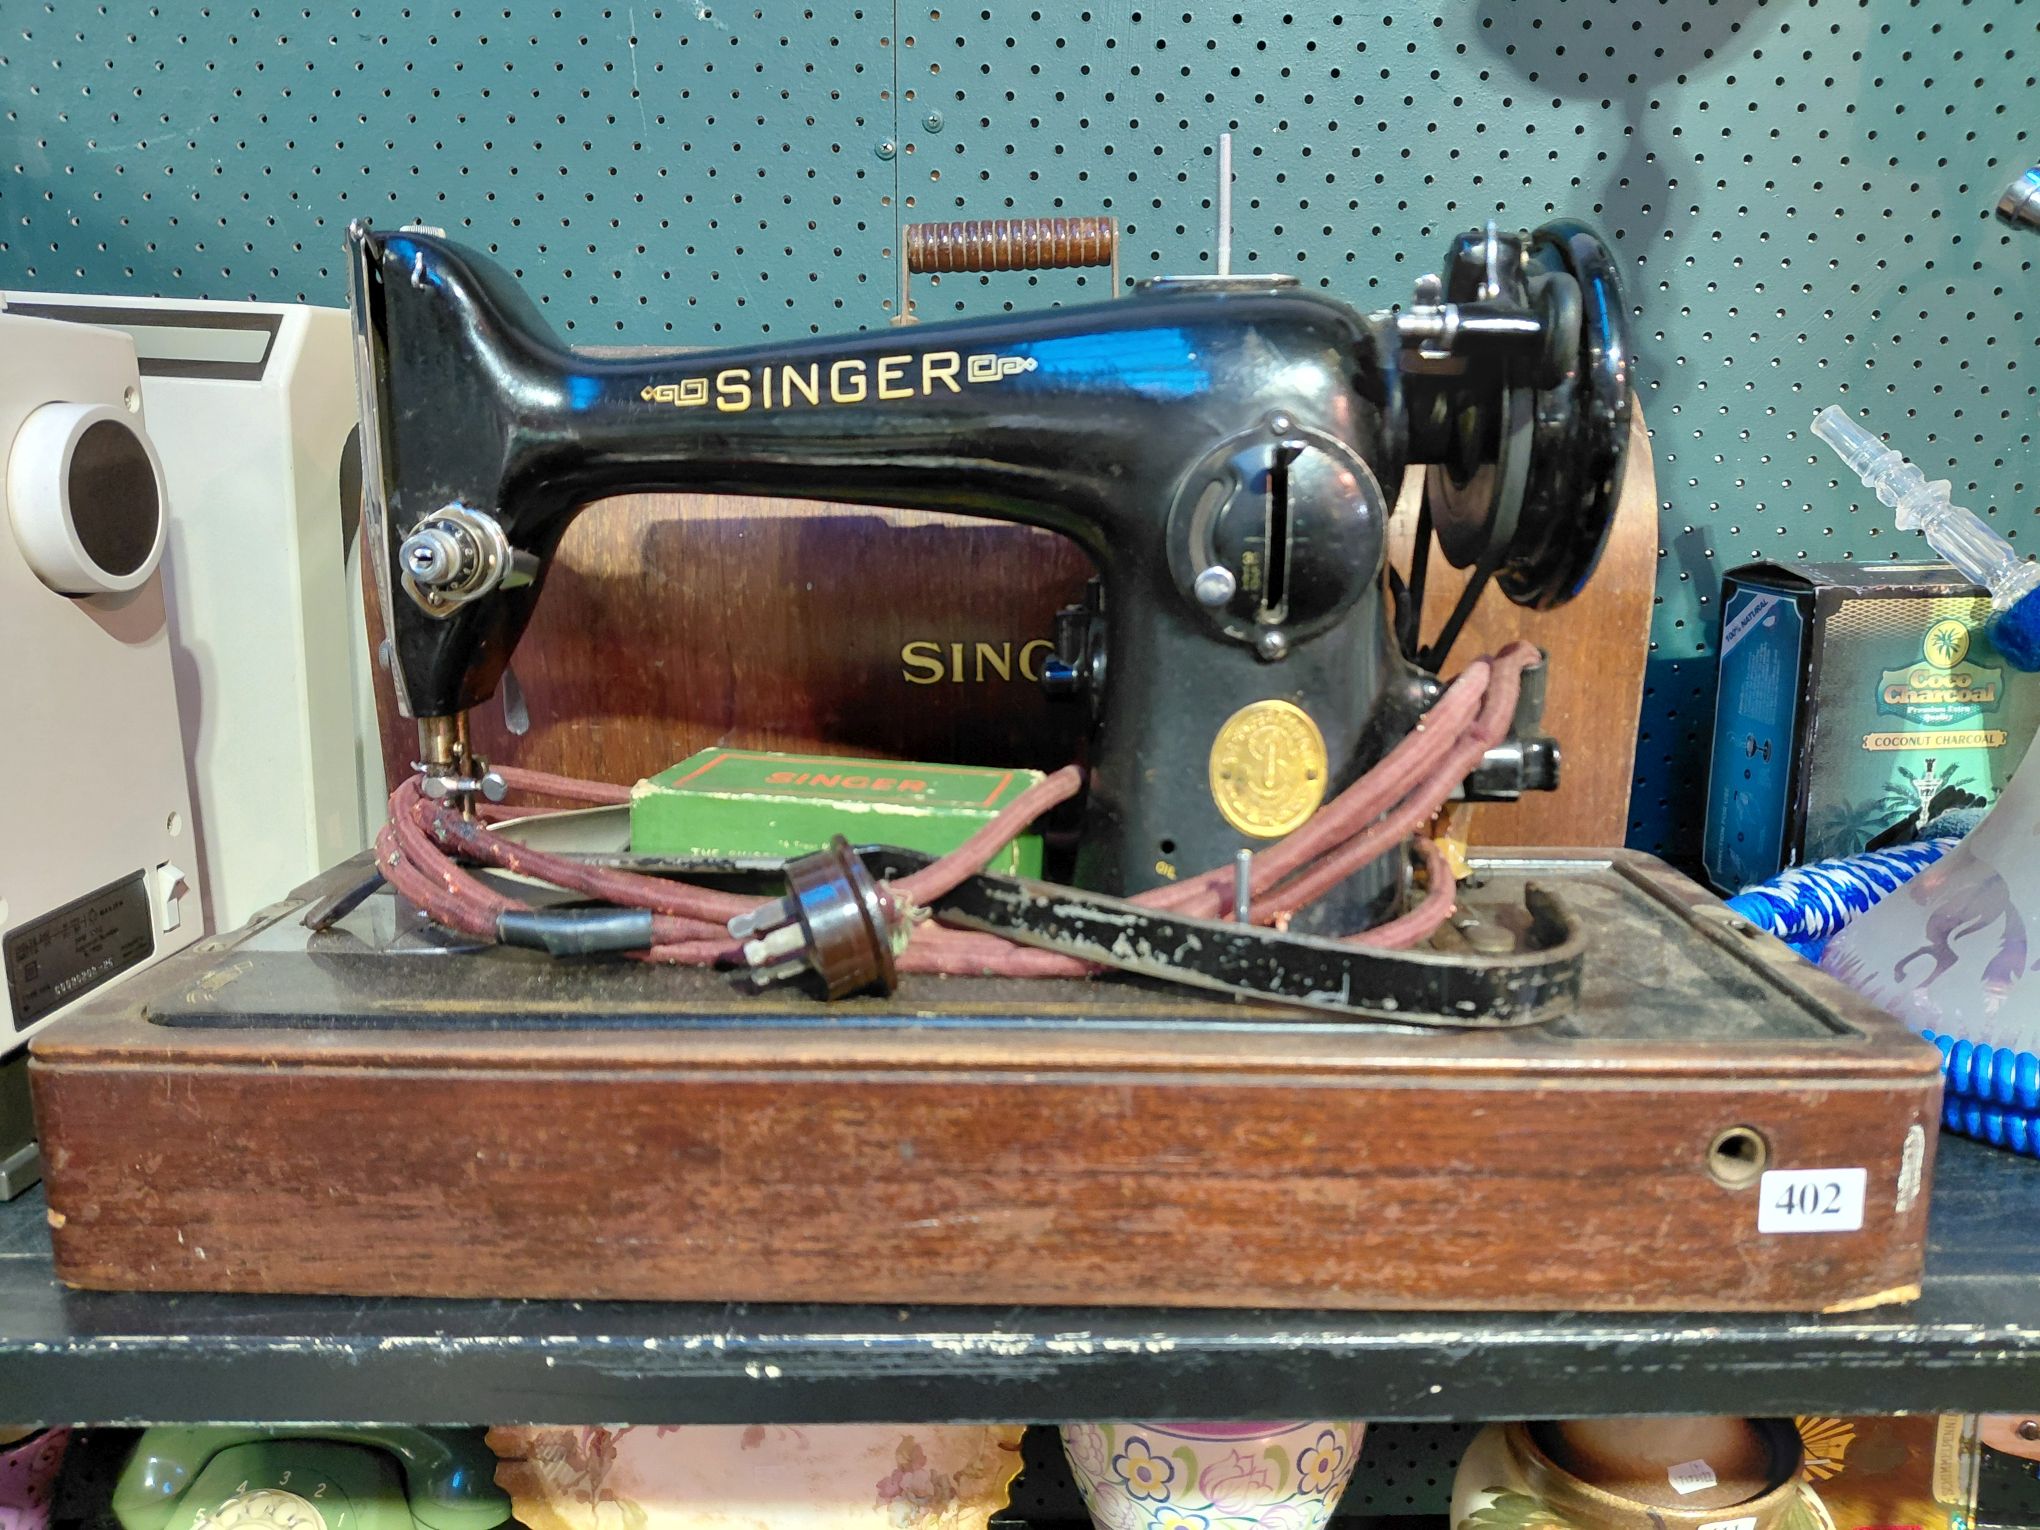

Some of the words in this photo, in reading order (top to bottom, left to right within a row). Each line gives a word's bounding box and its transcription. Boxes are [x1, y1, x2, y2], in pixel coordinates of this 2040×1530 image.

[716, 351, 962, 412] SINGER
[1741, 600, 1768, 627] NATURAL
[1910, 668, 1973, 689] Coco
[1883, 682, 1996, 704] Charcoal
[1874, 736, 1932, 747] COCONUT
[1935, 733, 1996, 745] CHARCOAL
[765, 771, 928, 793] SINGER
[1774, 1182, 1842, 1215] 402
[236, 1480, 249, 1494] 4
[279, 1471, 292, 1486] 3
[314, 1483, 327, 1498] 2
[337, 1512, 346, 1528] 1
